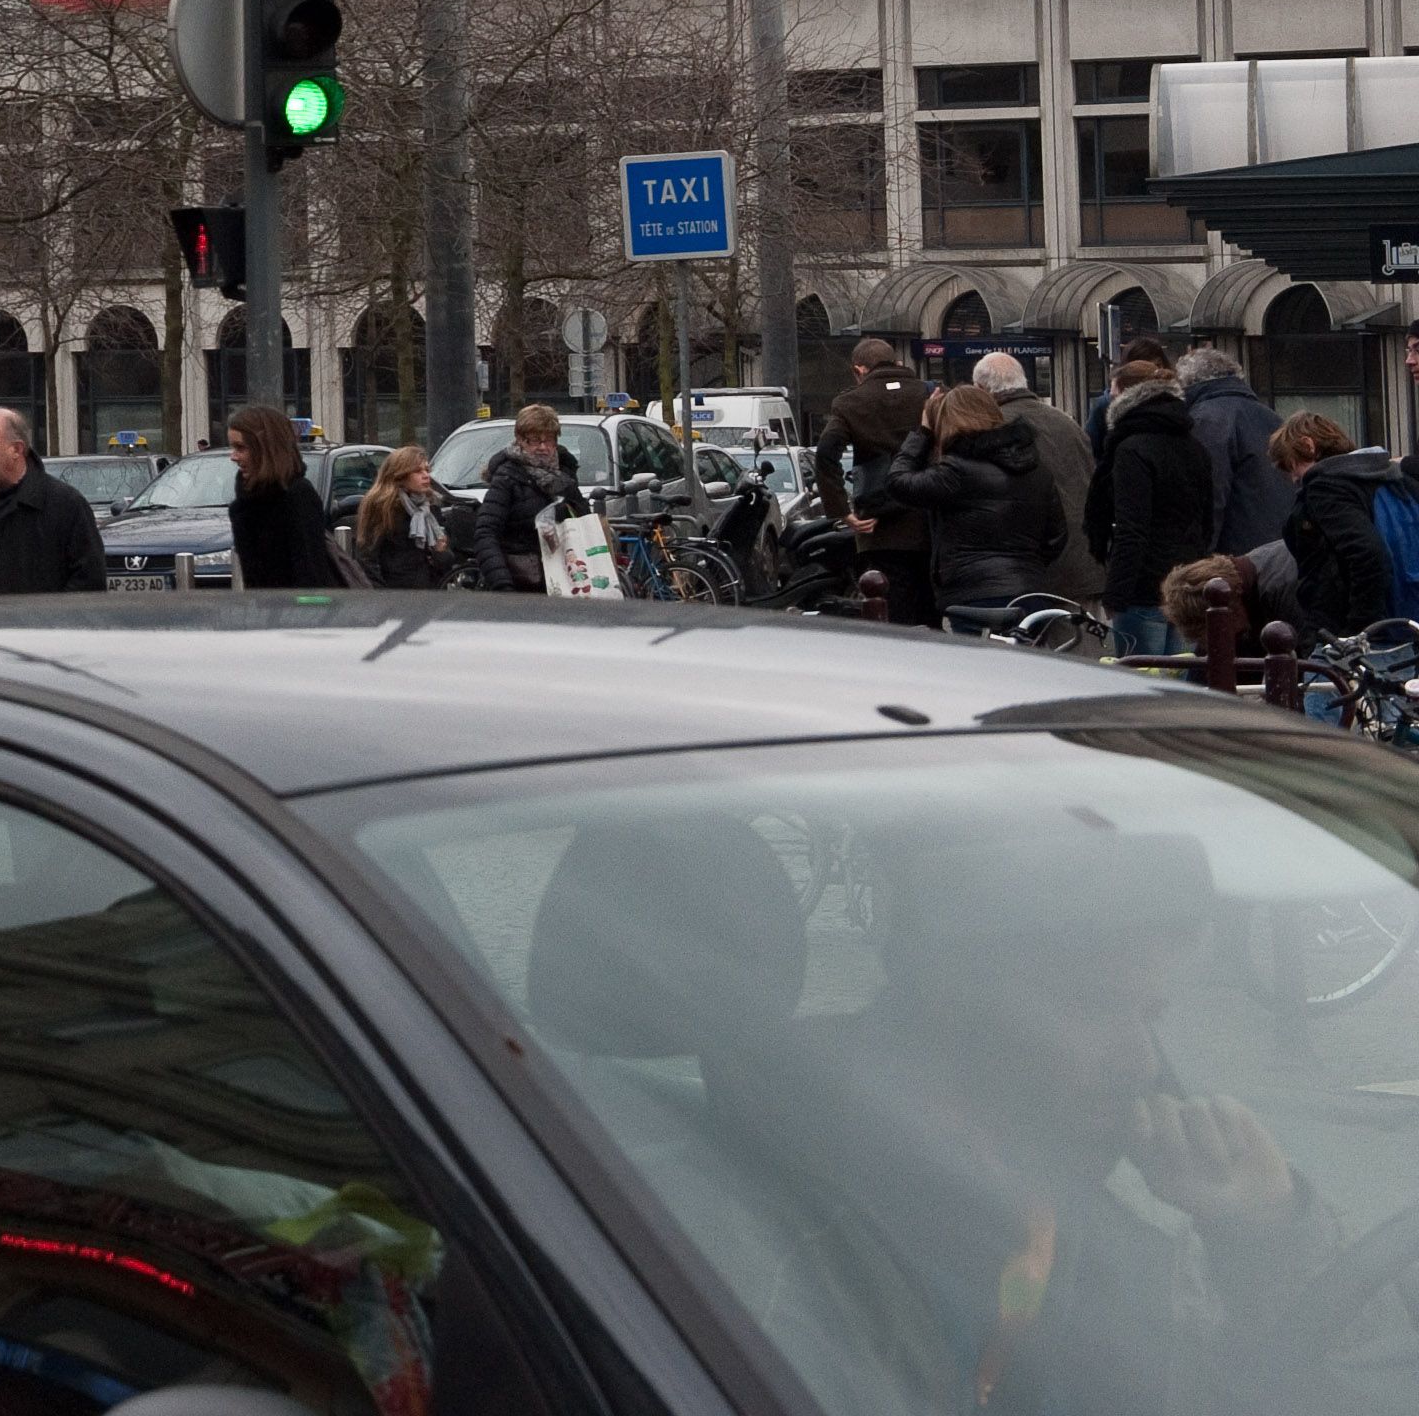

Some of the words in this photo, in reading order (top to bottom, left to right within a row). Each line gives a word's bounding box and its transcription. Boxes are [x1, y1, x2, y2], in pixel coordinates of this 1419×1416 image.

[643, 176, 710, 204] TAXI
[640, 221, 663, 237] TÊTE
[677, 220, 719, 235] STATION
